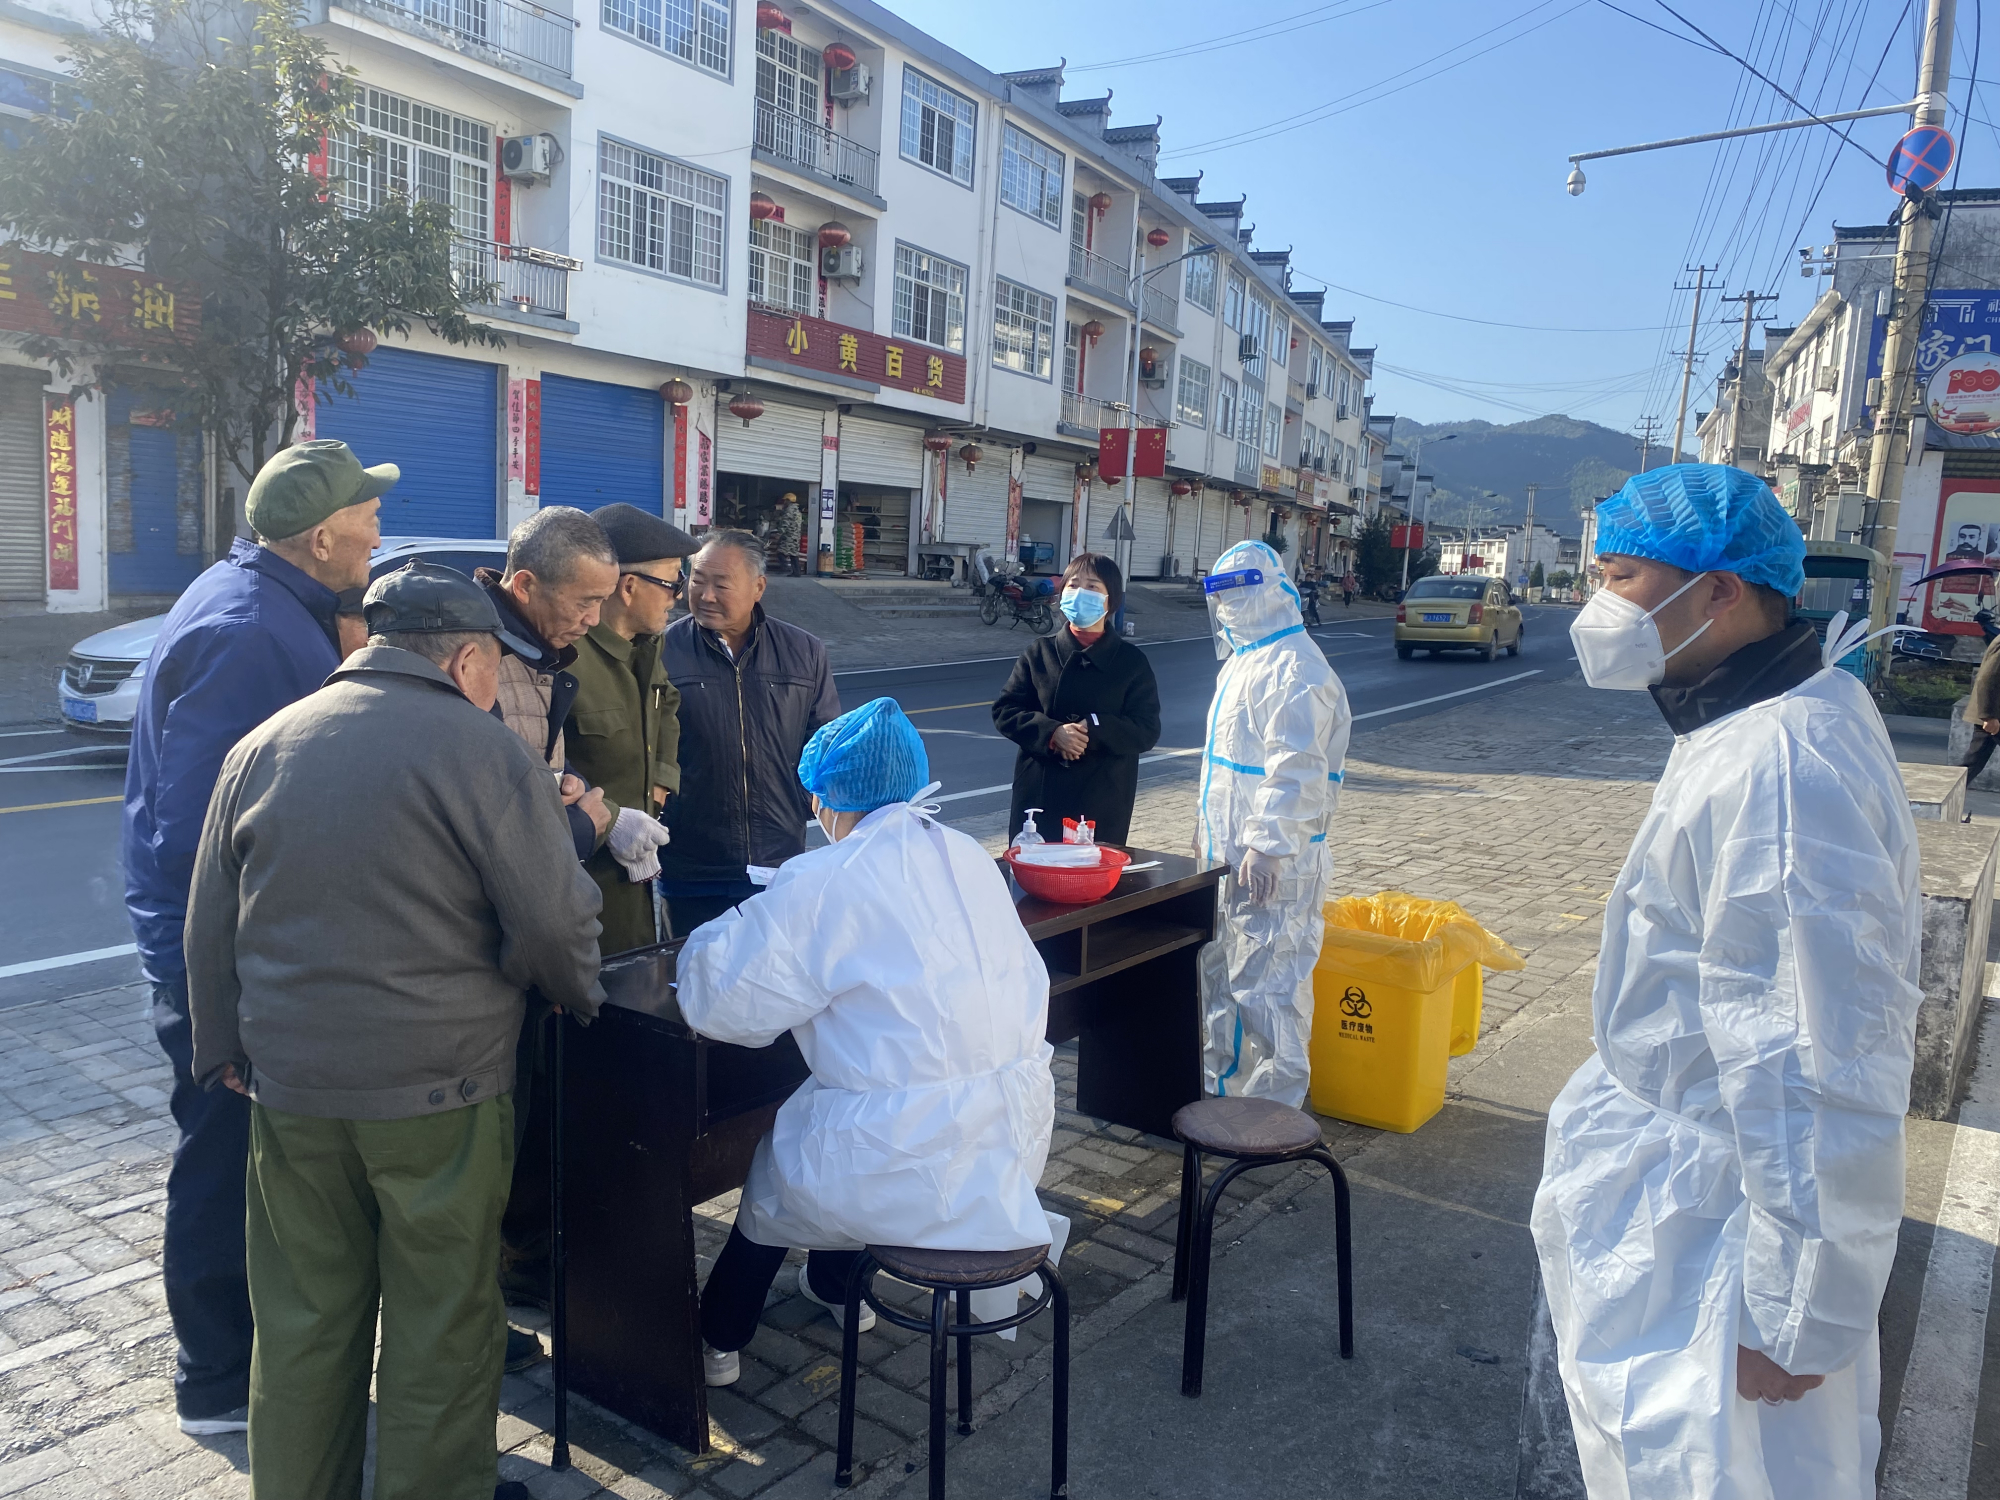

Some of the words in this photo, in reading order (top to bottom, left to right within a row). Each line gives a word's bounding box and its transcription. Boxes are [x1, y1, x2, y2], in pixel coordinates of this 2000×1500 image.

[785, 320, 944, 389] 小黄百货
[1341, 1020, 1373, 1034] 医疗废物
[1338, 1032, 1358, 1040] MEDICAL
[1360, 1035, 1375, 1043] WASTE
